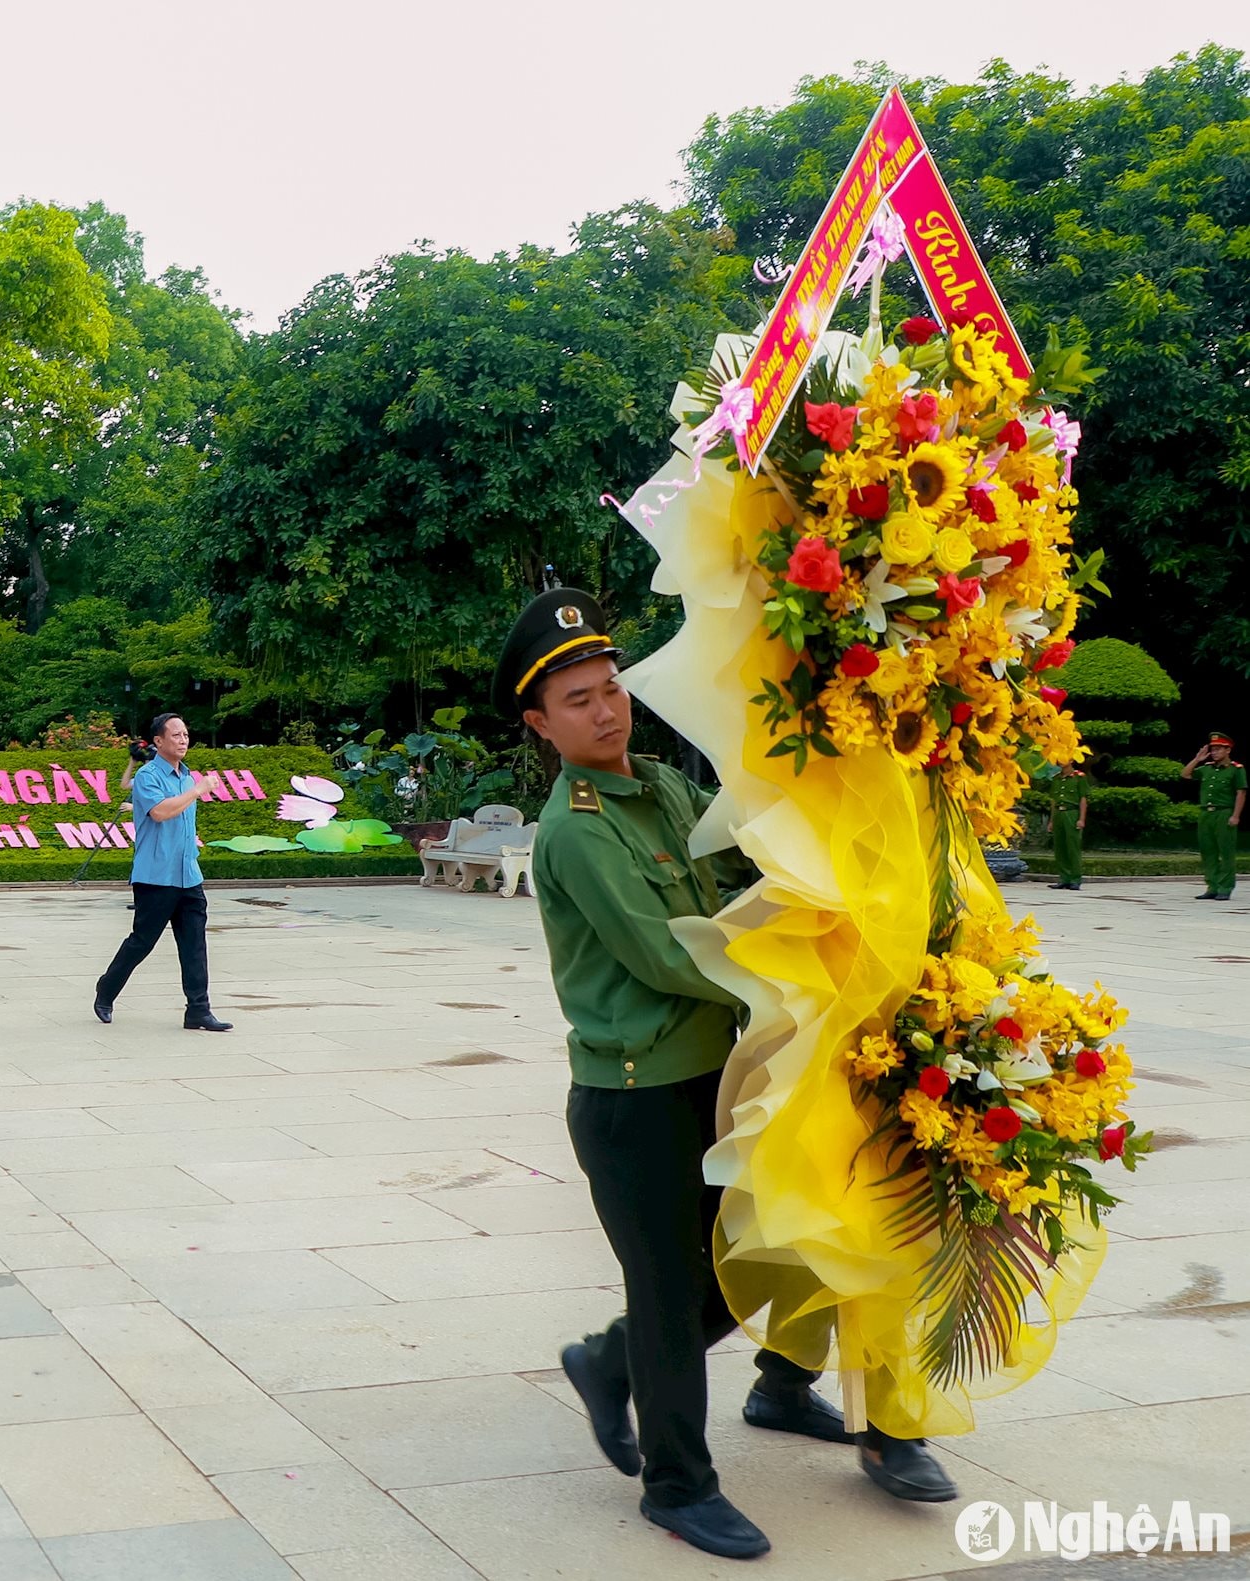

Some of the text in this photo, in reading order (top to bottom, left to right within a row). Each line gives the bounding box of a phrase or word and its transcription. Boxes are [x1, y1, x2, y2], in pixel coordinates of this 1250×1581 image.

[894, 135, 916, 169] NAM
[751, 340, 785, 405] Đồng
[781, 303, 801, 346] chí
[797, 243, 829, 305] TRẦN
[825, 174, 863, 251] THANH
